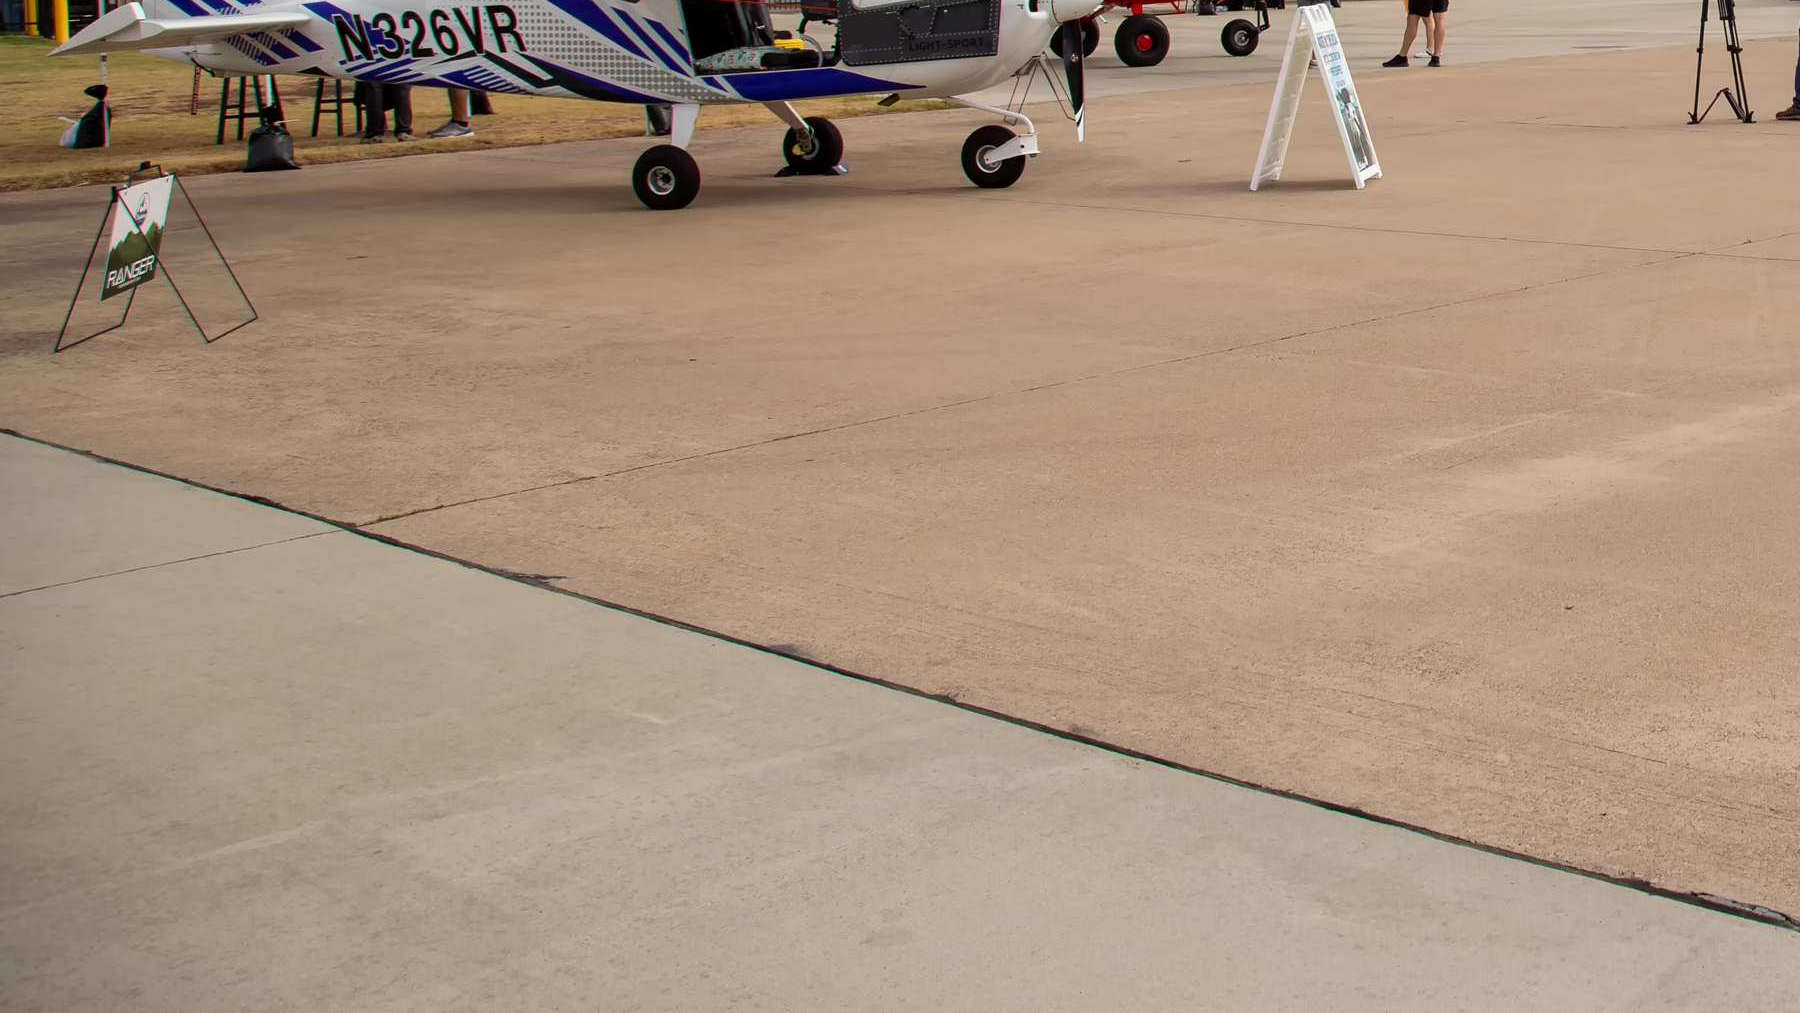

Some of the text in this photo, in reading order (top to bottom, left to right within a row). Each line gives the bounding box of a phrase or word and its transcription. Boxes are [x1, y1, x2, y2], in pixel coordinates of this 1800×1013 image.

[332, 5, 528, 63] N326VR
[909, 37, 985, 52] LIGHT-SPORT
[106, 255, 156, 289] RANGER
